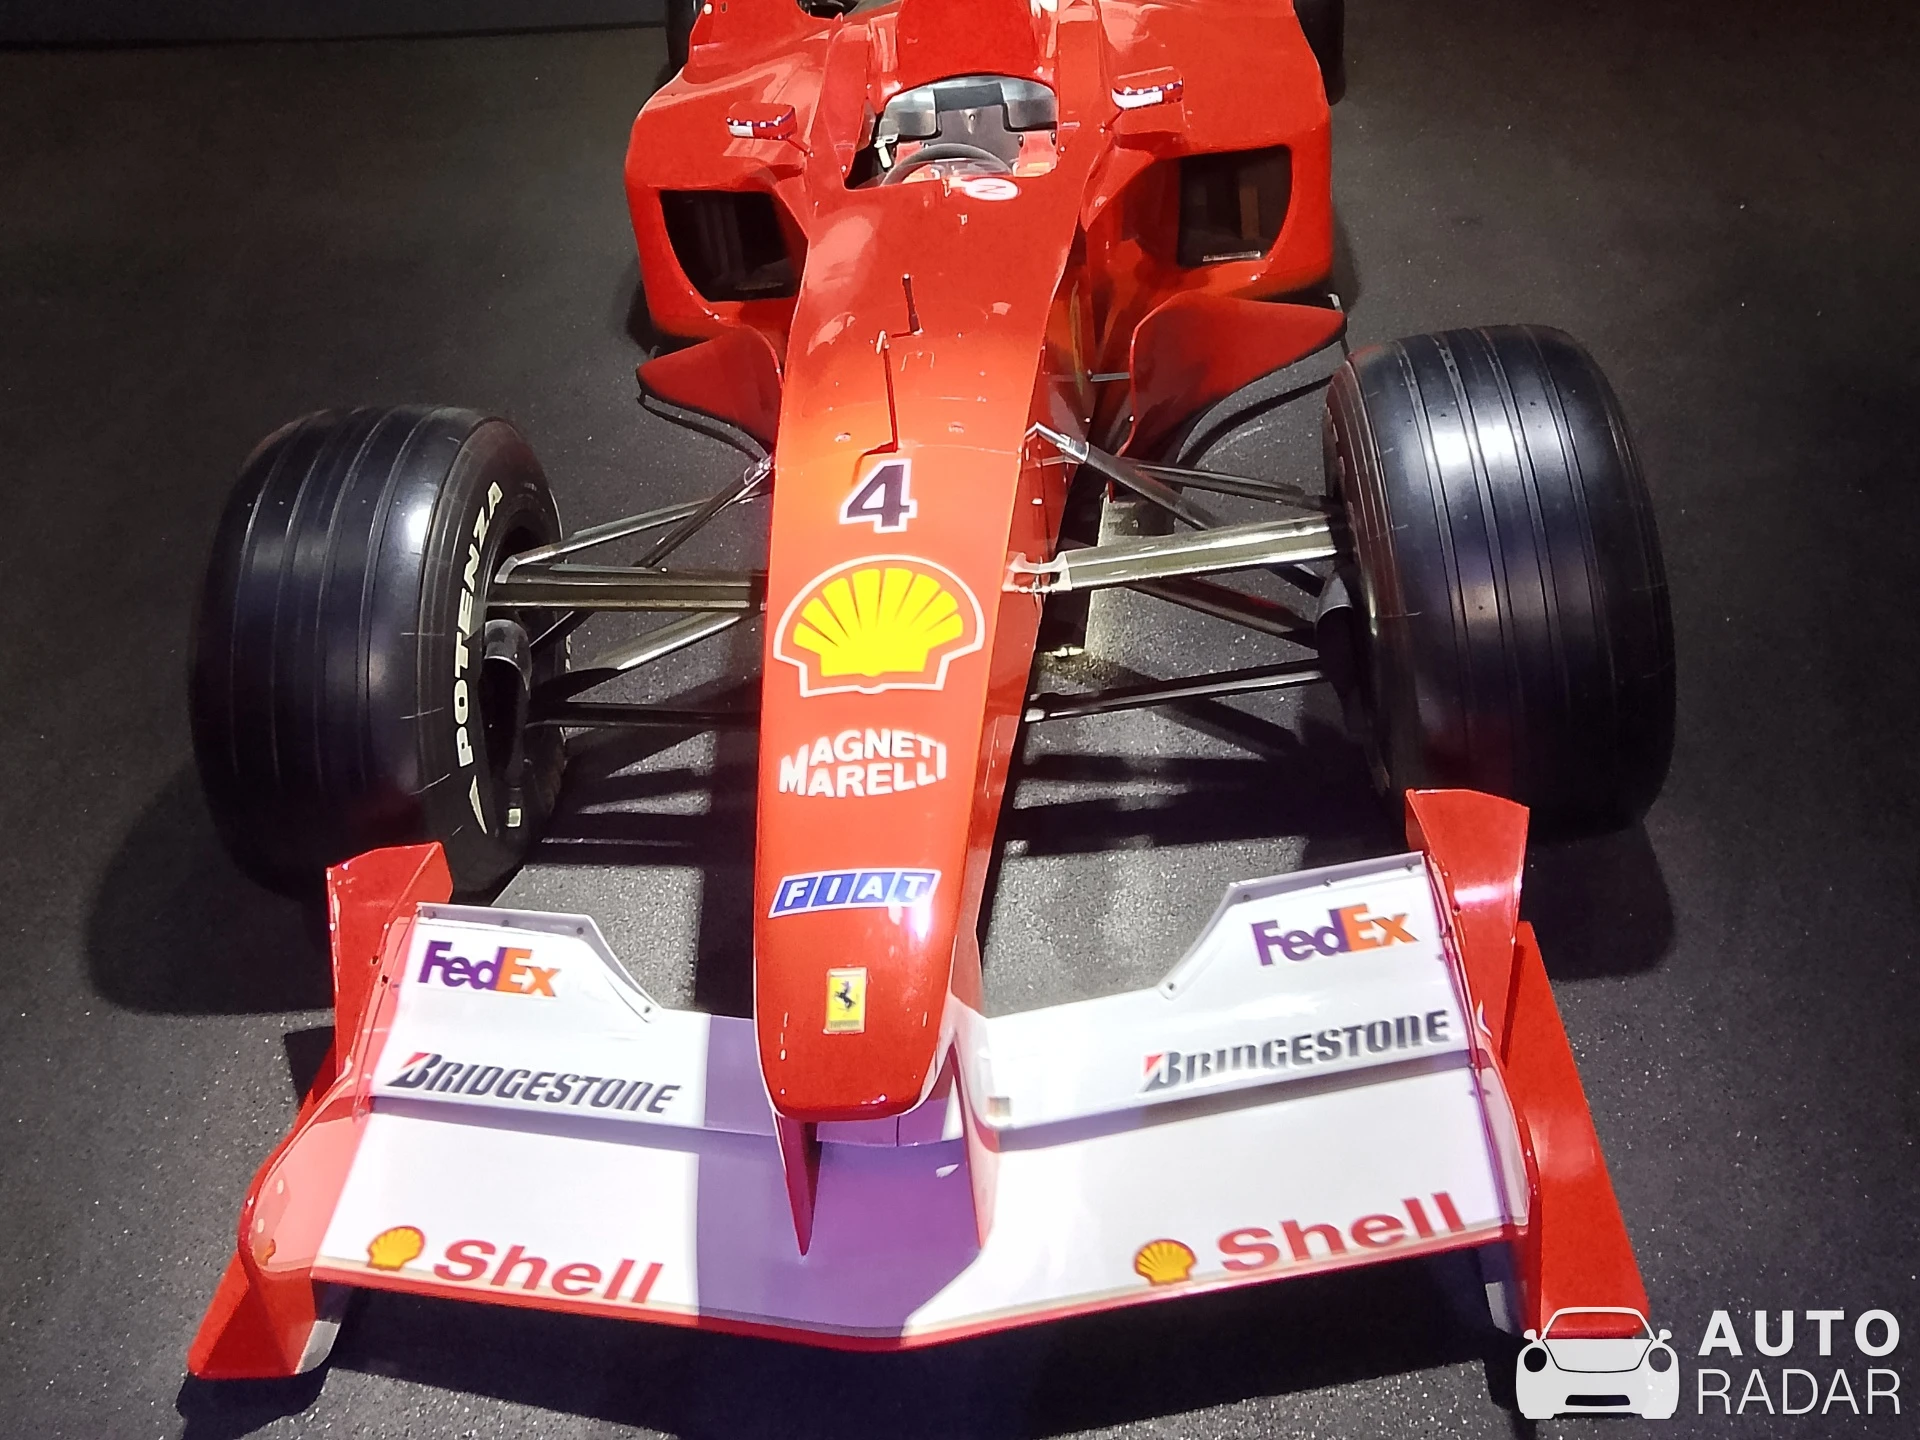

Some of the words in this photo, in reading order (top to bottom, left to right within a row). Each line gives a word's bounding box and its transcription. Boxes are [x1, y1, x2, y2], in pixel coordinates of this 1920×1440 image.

[840, 458, 918, 533] 4
[454, 481, 503, 767] POTENZA
[779, 728, 947, 776] MAGNETI
[779, 751, 947, 798] MARELLI
[780, 874, 931, 909] FIAT
[1250, 903, 1419, 967] FedEx
[418, 940, 561, 998] FedEx
[387, 1052, 682, 1114] BRIDGESTONE
[1217, 1191, 1466, 1272] Shell
[433, 1239, 664, 1304] Shell
